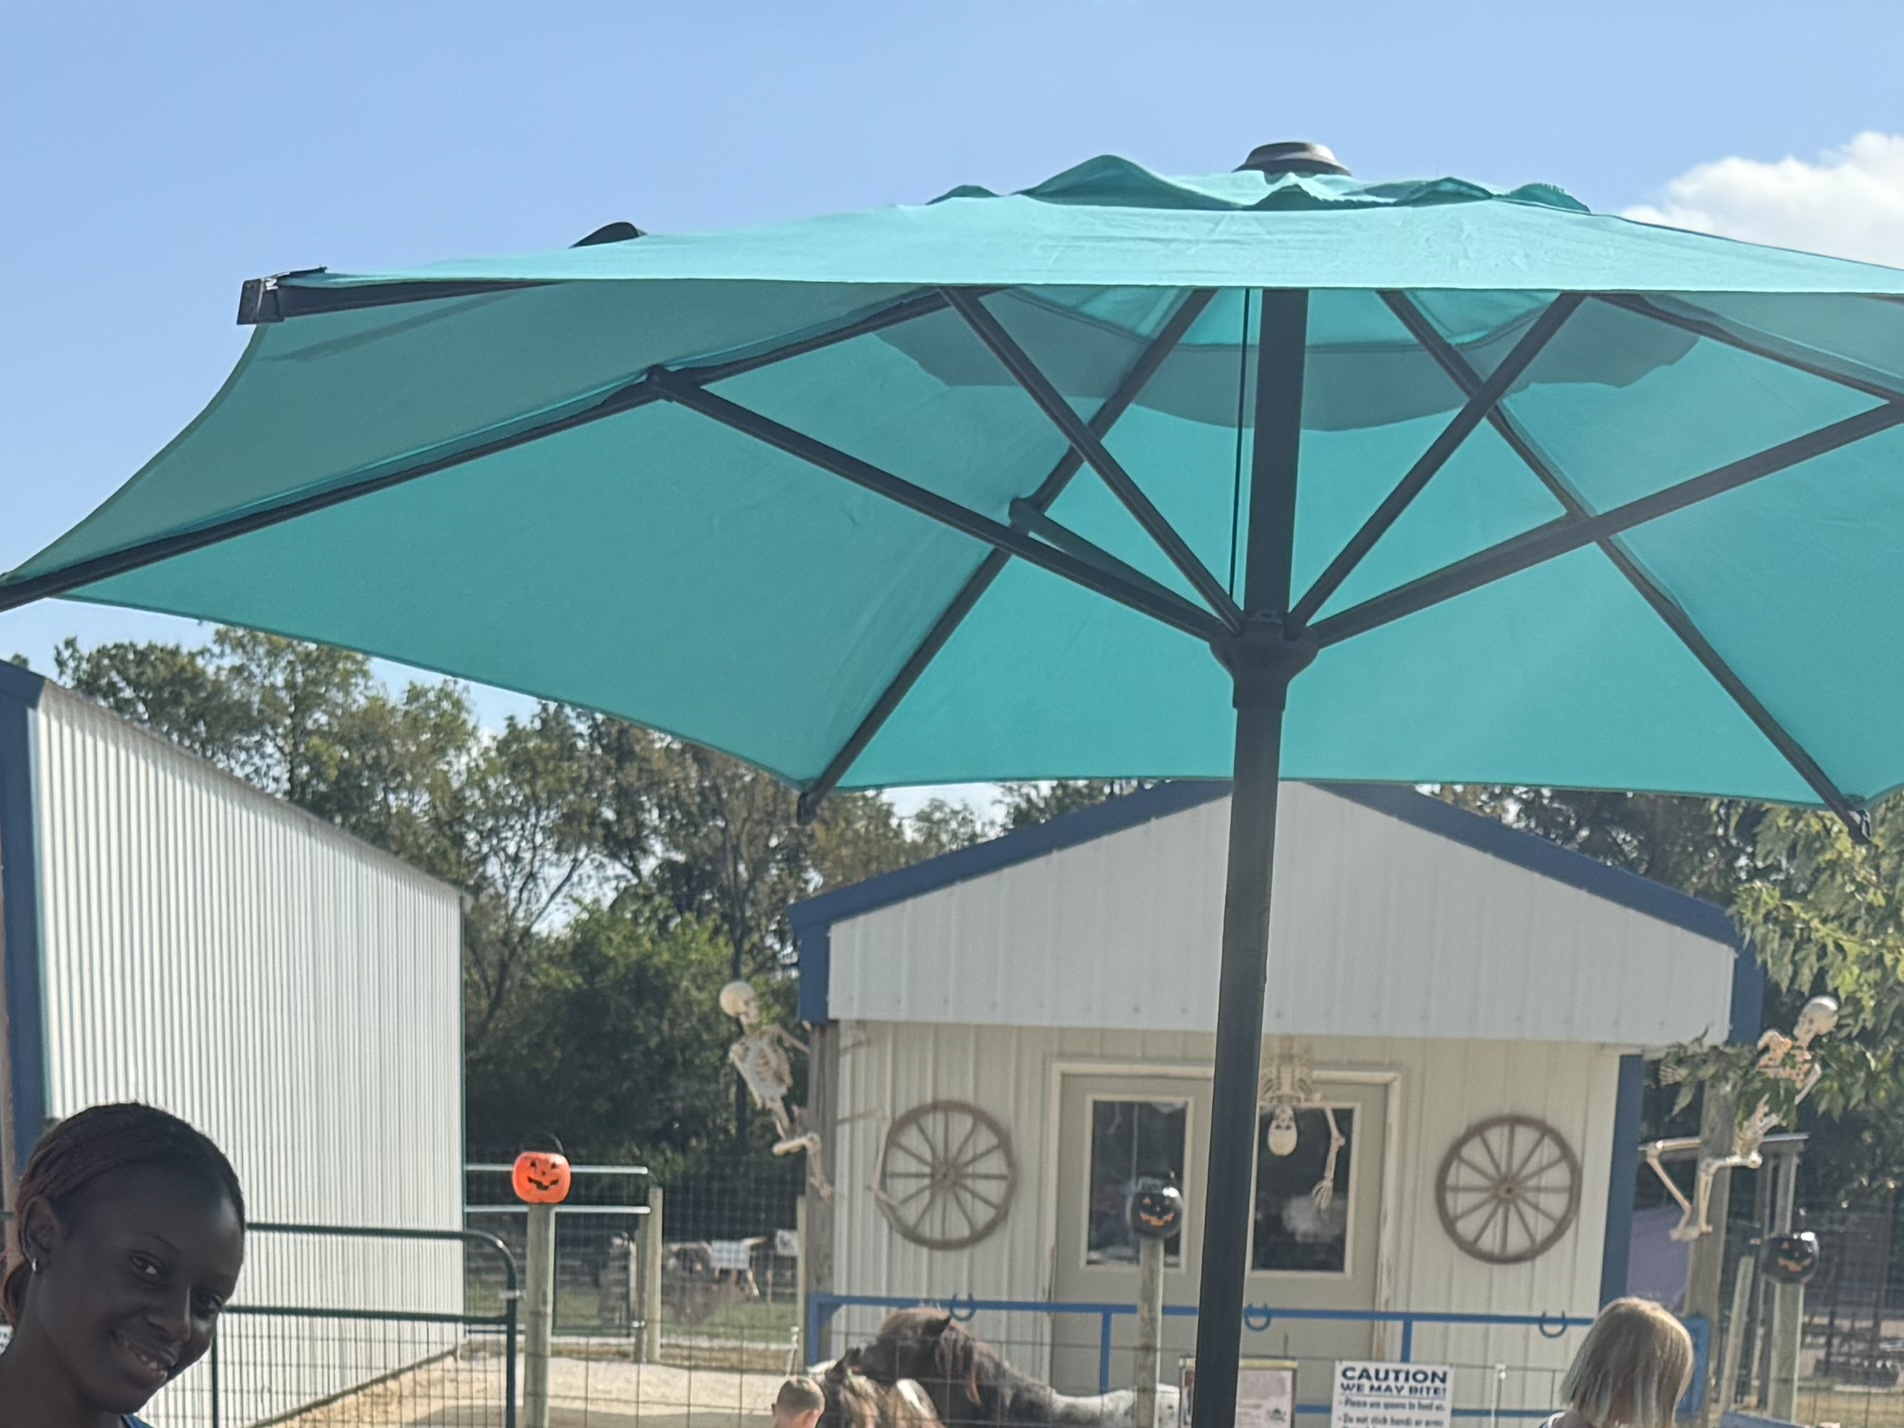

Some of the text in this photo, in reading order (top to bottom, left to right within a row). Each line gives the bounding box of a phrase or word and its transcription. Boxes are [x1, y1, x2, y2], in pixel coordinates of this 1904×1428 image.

[1341, 1366, 1447, 1384] CAUTION
[1341, 1382, 1448, 1397] WE MAY BITE!
